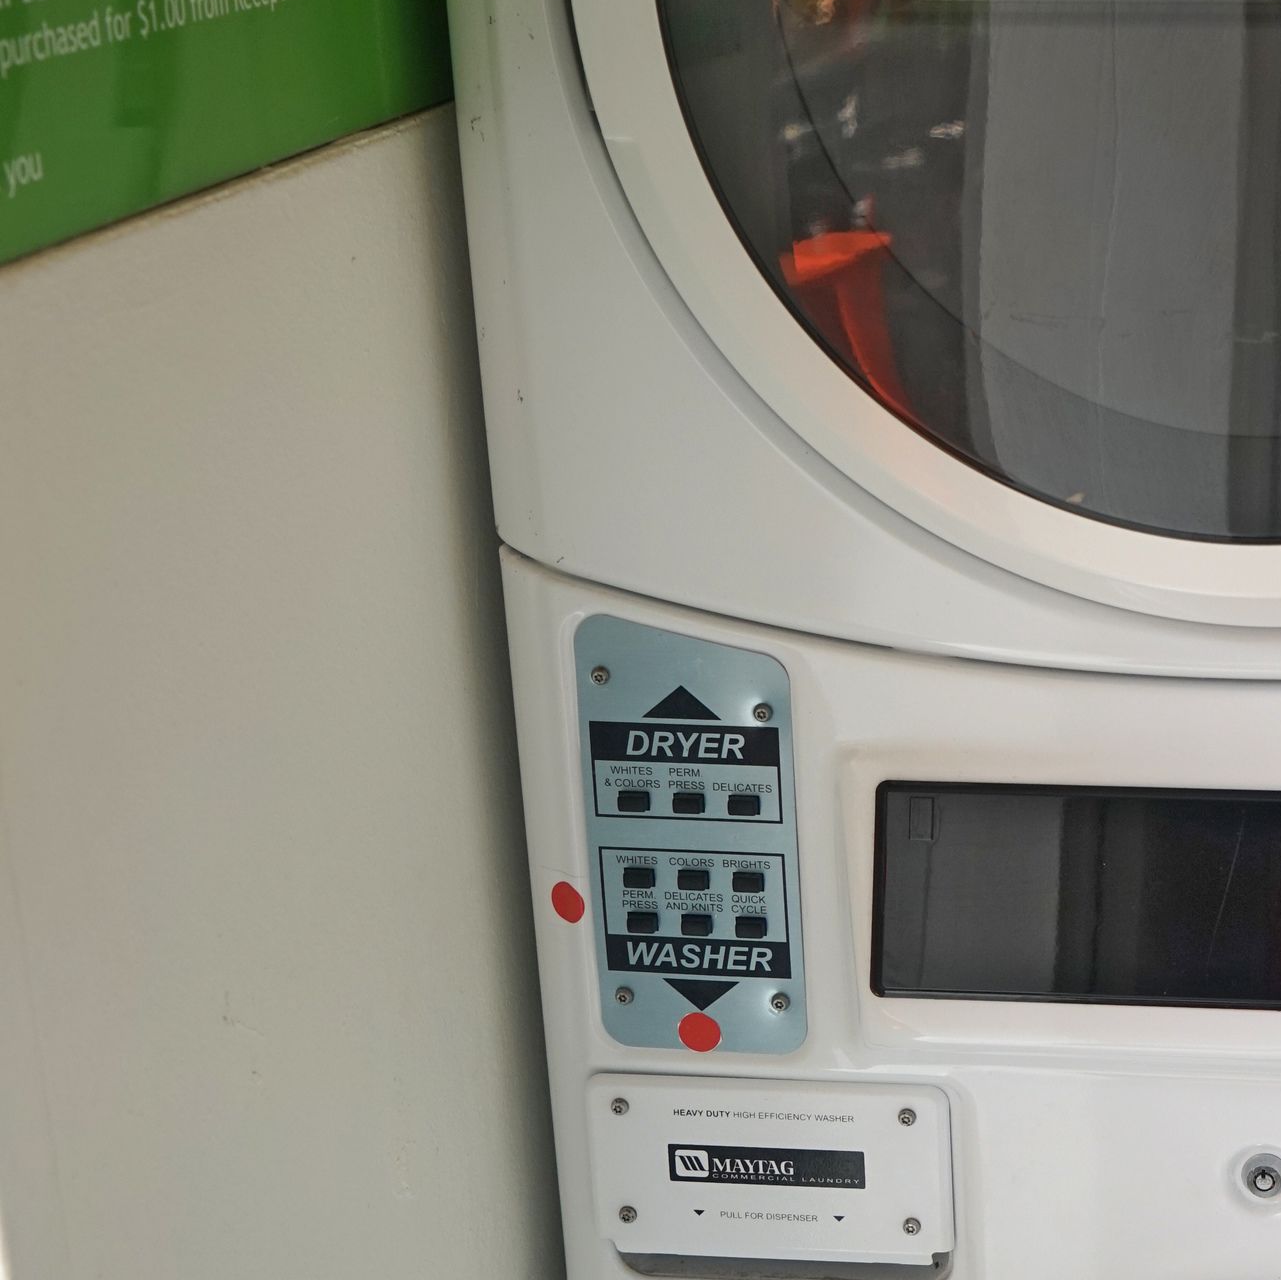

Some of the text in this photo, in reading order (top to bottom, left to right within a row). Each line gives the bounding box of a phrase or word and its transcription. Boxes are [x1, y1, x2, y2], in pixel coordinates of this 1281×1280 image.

[1, 9, 101, 79] purchased
[105, 4, 132, 43] for
[4, 151, 43, 199] you
[626, 729, 746, 760] DRYER
[610, 765, 653, 776] WHITES
[669, 767, 703, 778] PERM.
[604, 778, 661, 789] & COLORS
[668, 780, 705, 791] PRESS
[712, 782, 773, 794] DELICATES
[616, 855, 658, 865] WHITES
[669, 856, 715, 868] COLORS
[722, 859, 771, 870] BRIGHTS
[622, 889, 656, 900] PERM.
[664, 891, 724, 903] DELICATES
[731, 894, 766, 905] QUICK
[622, 900, 659, 910] PRESS
[665, 901, 724, 913] AND KNITS
[731, 904, 767, 915] CYCLE
[626, 940, 773, 972] WASHER
[673, 1108, 855, 1123] HEAVY DUTY HIGH EFFICIENCY WASHER
[712, 1157, 794, 1176] MAYTAG
[712, 1173, 861, 1185] COMMERCIAL LAUNDRY
[720, 1210, 818, 1222] PULL FOR DISPENSER
